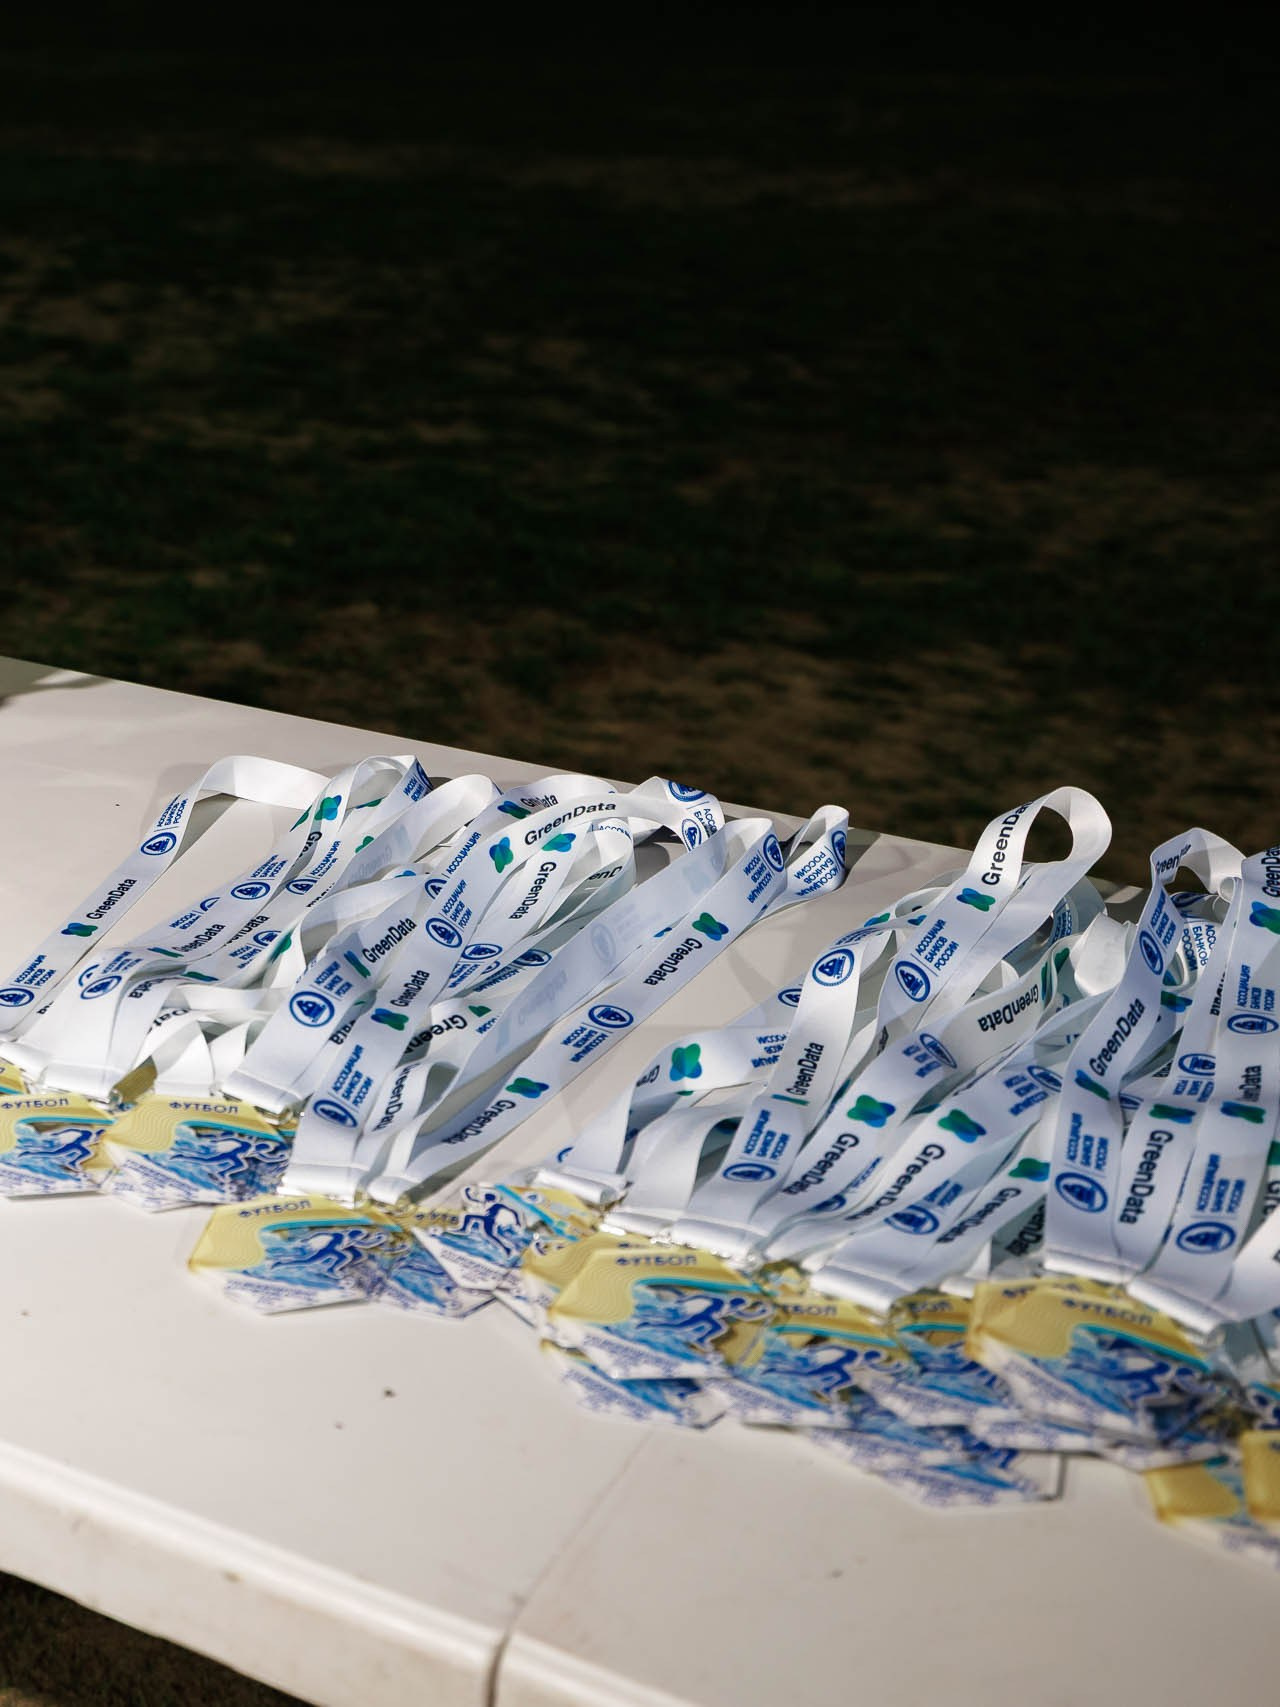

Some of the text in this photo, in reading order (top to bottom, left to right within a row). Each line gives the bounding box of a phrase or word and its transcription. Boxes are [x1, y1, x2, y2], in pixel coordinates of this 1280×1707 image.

[524, 801, 617, 846] GreenData
[446, 831, 482, 875] АССОЦИАЦИЯ
[793, 849, 827, 879] РОССИИ
[803, 857, 835, 887] БАНКОВ
[86, 878, 137, 920] GreenData
[441, 879, 467, 914] АССОЦИАЦИЯ
[508, 861, 557, 920] GreenData
[449, 900, 465, 922] БАНКОВ
[363, 916, 417, 964] GreenData
[916, 919, 946, 955] АССОЦИАЦИЯ
[924, 936, 948, 963] БАНКОВ
[1183, 929, 1198, 972] РОССИИ
[1192, 926, 1208, 966] БАНКОВ
[14, 954, 47, 983] АССОЦИАЦИЯ
[643, 937, 704, 987] GreenData
[934, 941, 960, 971] РОССИИ
[390, 969, 430, 1007] GreenData
[977, 984, 1039, 1032] GreenData
[560, 1026, 585, 1046] РОССИИ
[570, 1032, 609, 1063] АССОЦИАЦИЯ
[572, 1029, 598, 1049] БАНКОВ
[1089, 998, 1145, 1077] GreenData
[332, 1044, 365, 1092] АССОЦИАЦИЯ
[341, 1070, 363, 1101] БАНКОВ
[352, 1077, 374, 1107] РОССИИ
[0, 1097, 69, 1111] ФУТБОЛ
[168, 1101, 239, 1115] ФУТБОЛ
[441, 1099, 517, 1145] GreenData
[1118, 1129, 1174, 1225] GreenData
[238, 1200, 312, 1219] ФУТБОЛ
[615, 1254, 698, 1267] ФУТБОЛ
[1062, 1298, 1154, 1325] ФУТБОЛ
